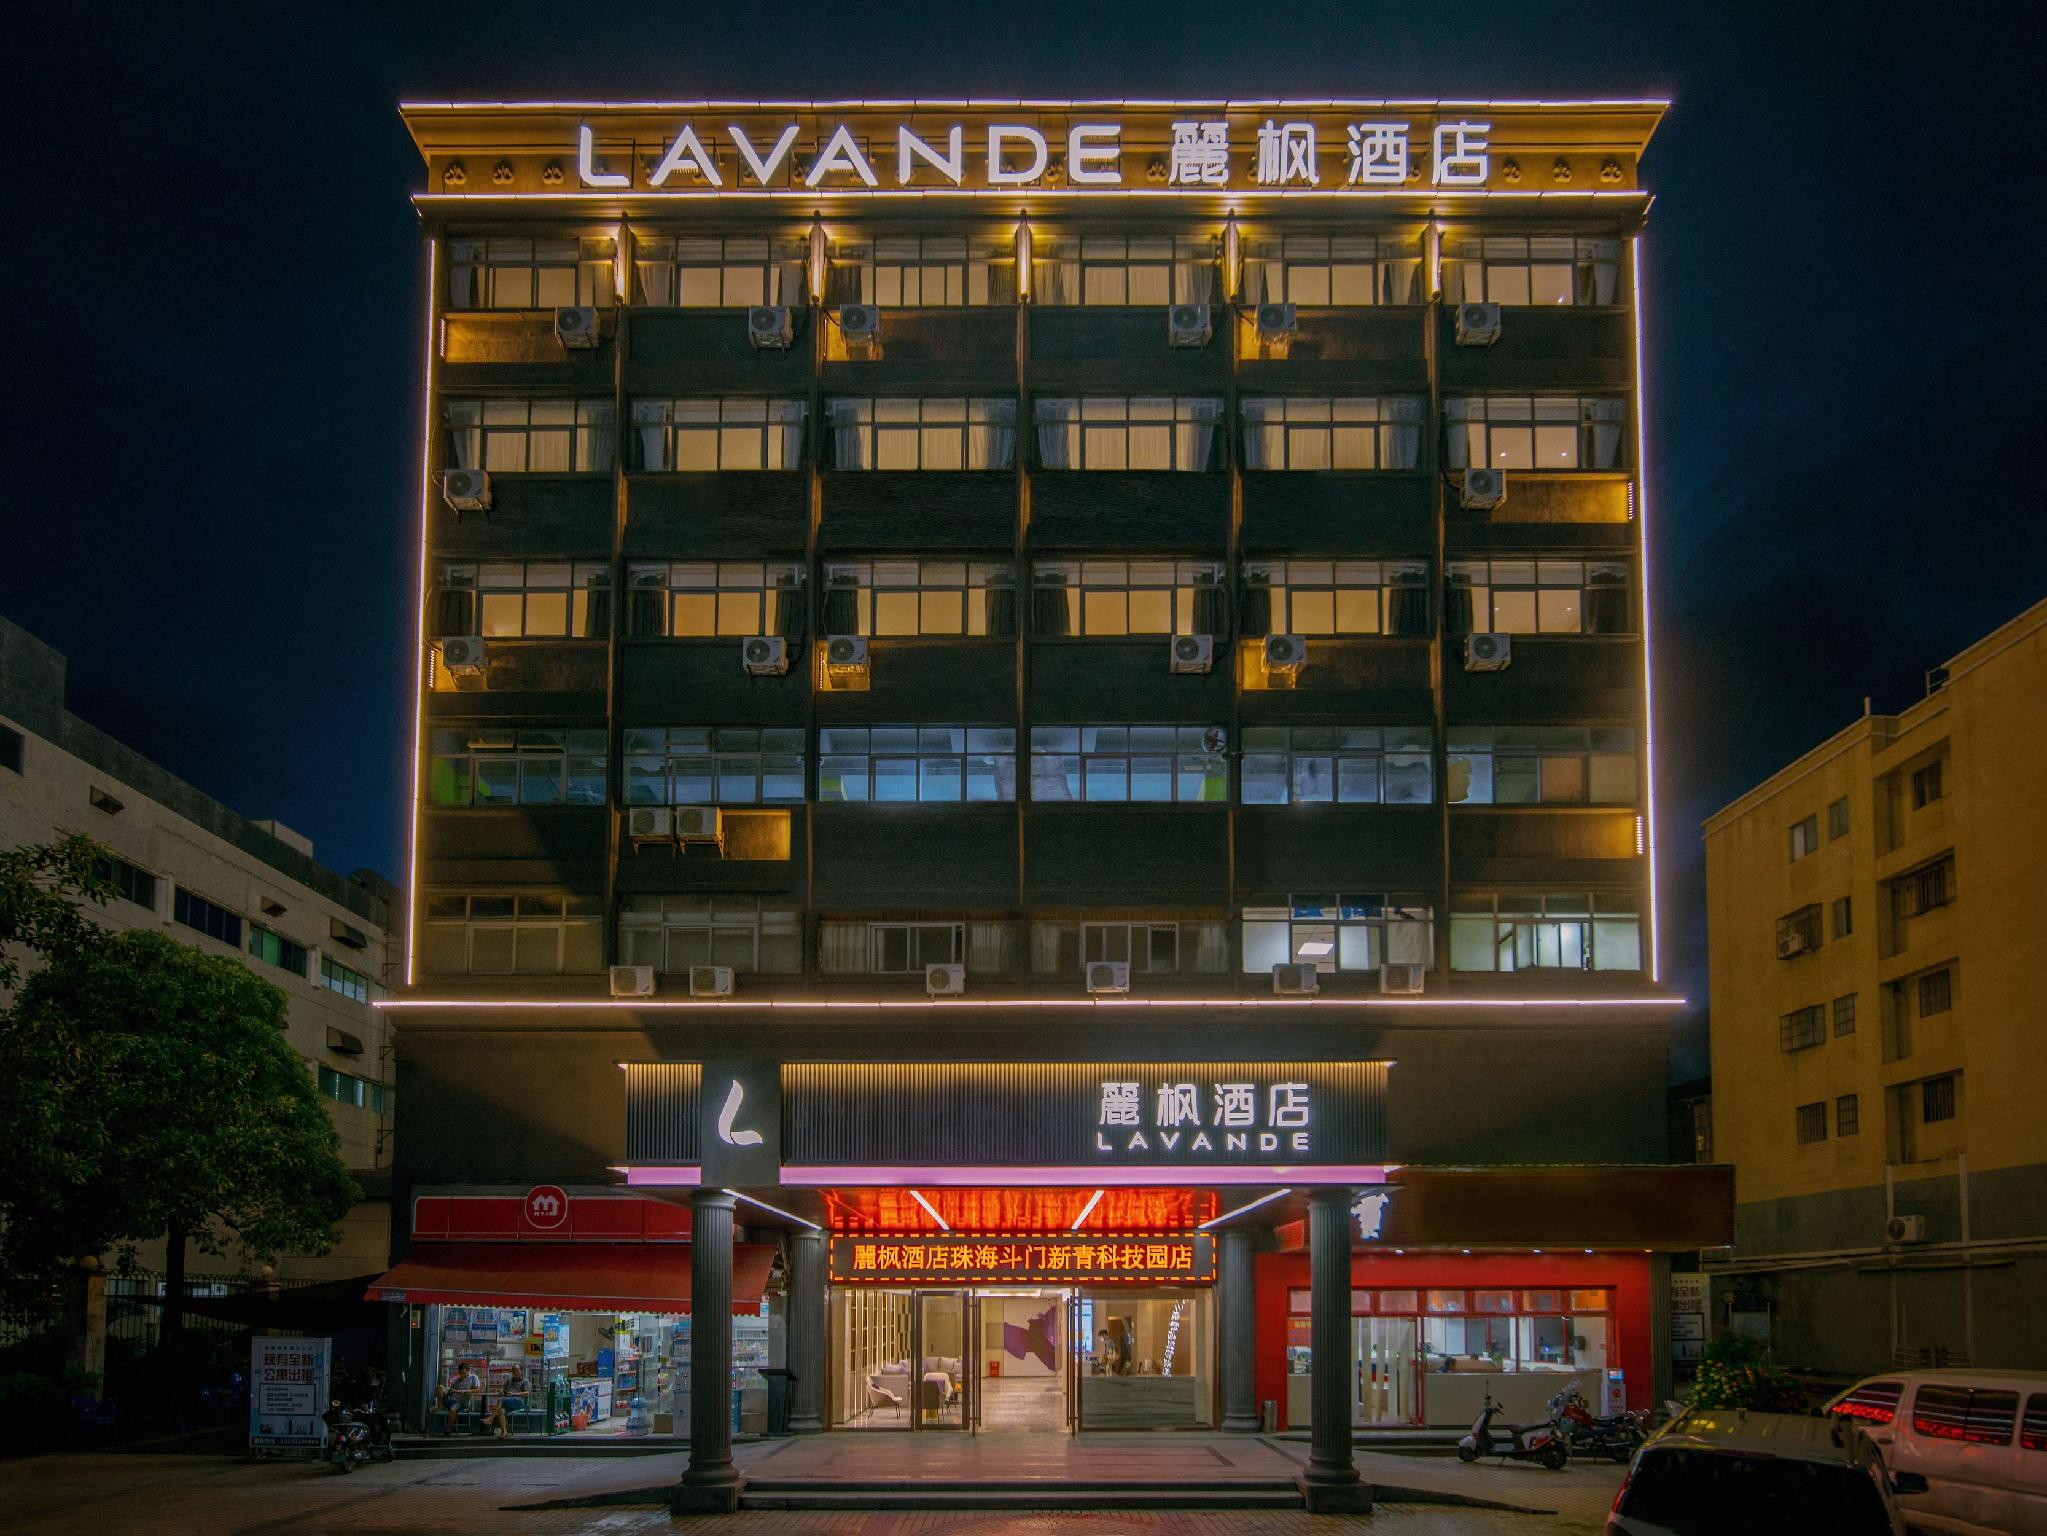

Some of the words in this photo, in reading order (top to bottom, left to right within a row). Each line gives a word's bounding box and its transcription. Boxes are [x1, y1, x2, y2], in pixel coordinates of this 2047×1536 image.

[579, 124, 1122, 187] LAVANDE
[1168, 119, 1490, 186] 麗枫酒店
[1099, 1081, 1309, 1127] 麗枫酒店
[1097, 1131, 1309, 1151] LAVANDE
[853, 1244, 1193, 1270] 麗枫酒店珠海斗门新青科技园店
[264, 1353, 314, 1366] 现有全新
